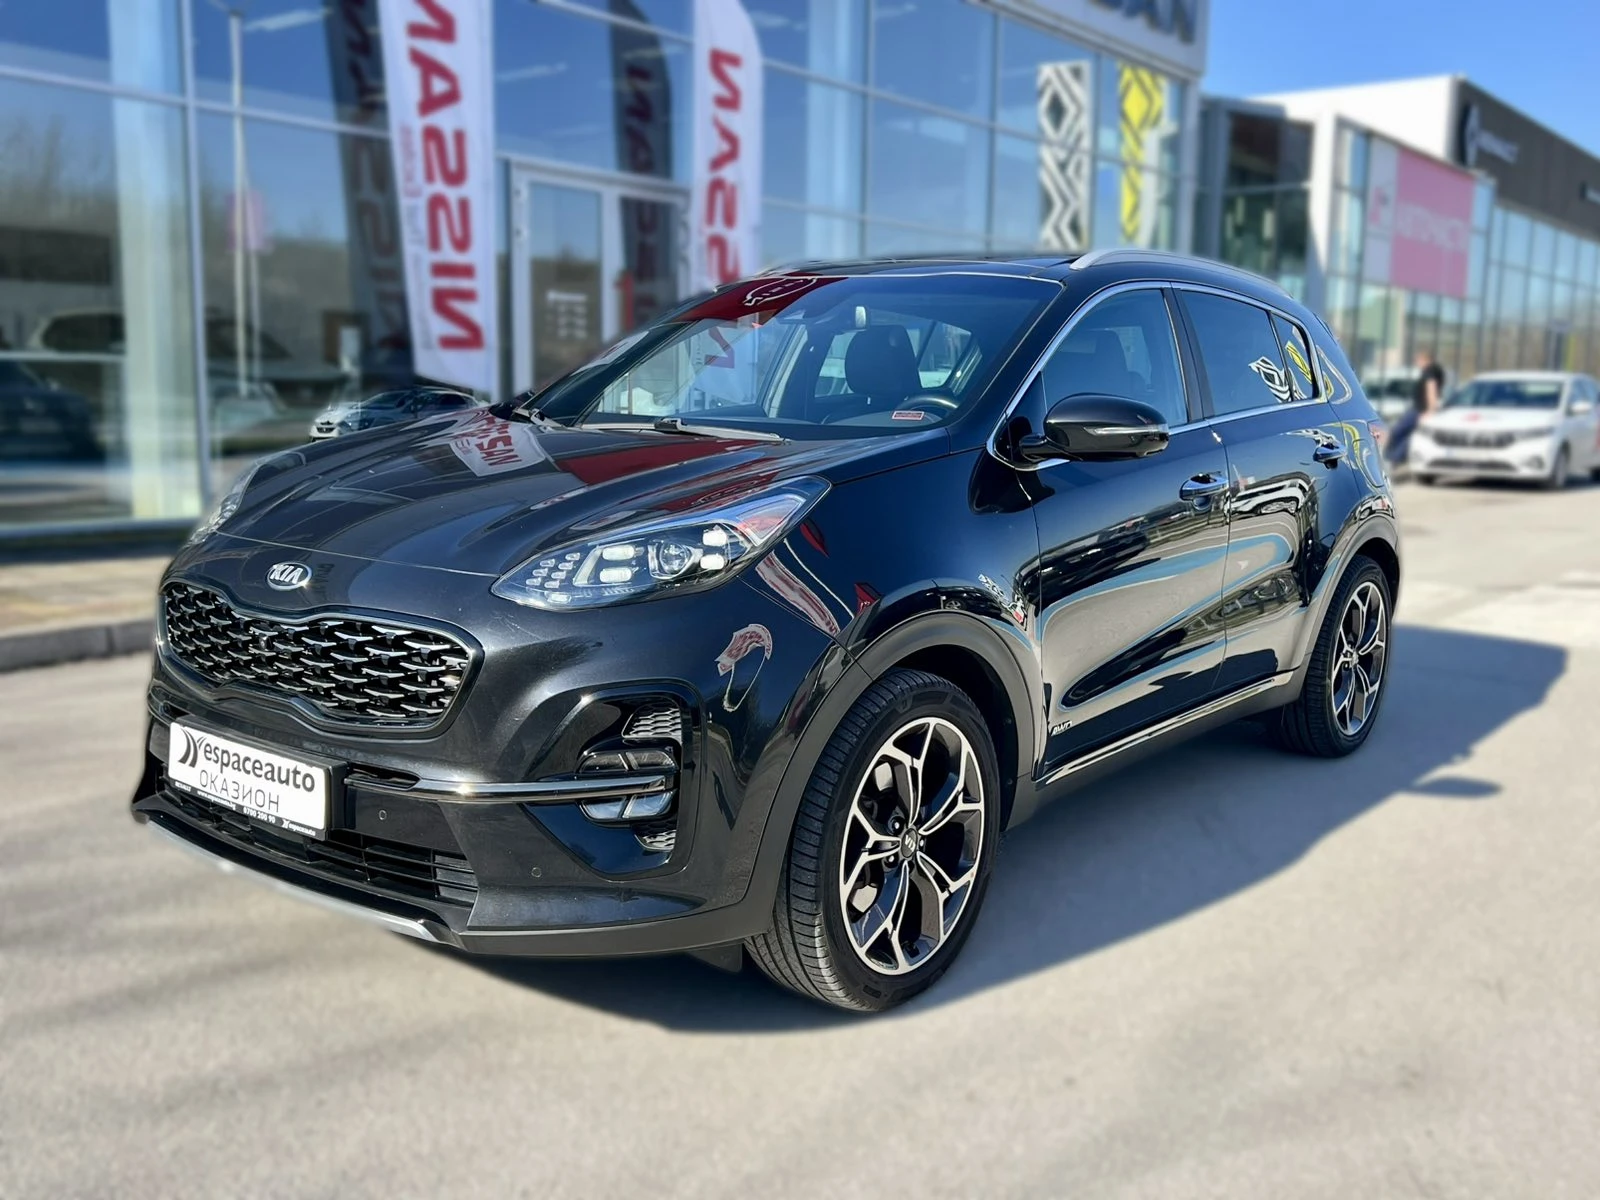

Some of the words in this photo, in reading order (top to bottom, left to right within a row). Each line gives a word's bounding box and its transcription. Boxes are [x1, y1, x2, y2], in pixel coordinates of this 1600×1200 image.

[270, 564, 303, 585] KIA
[203, 742, 316, 793] espaceauto
[199, 769, 280, 813] ОКАЗИОН
